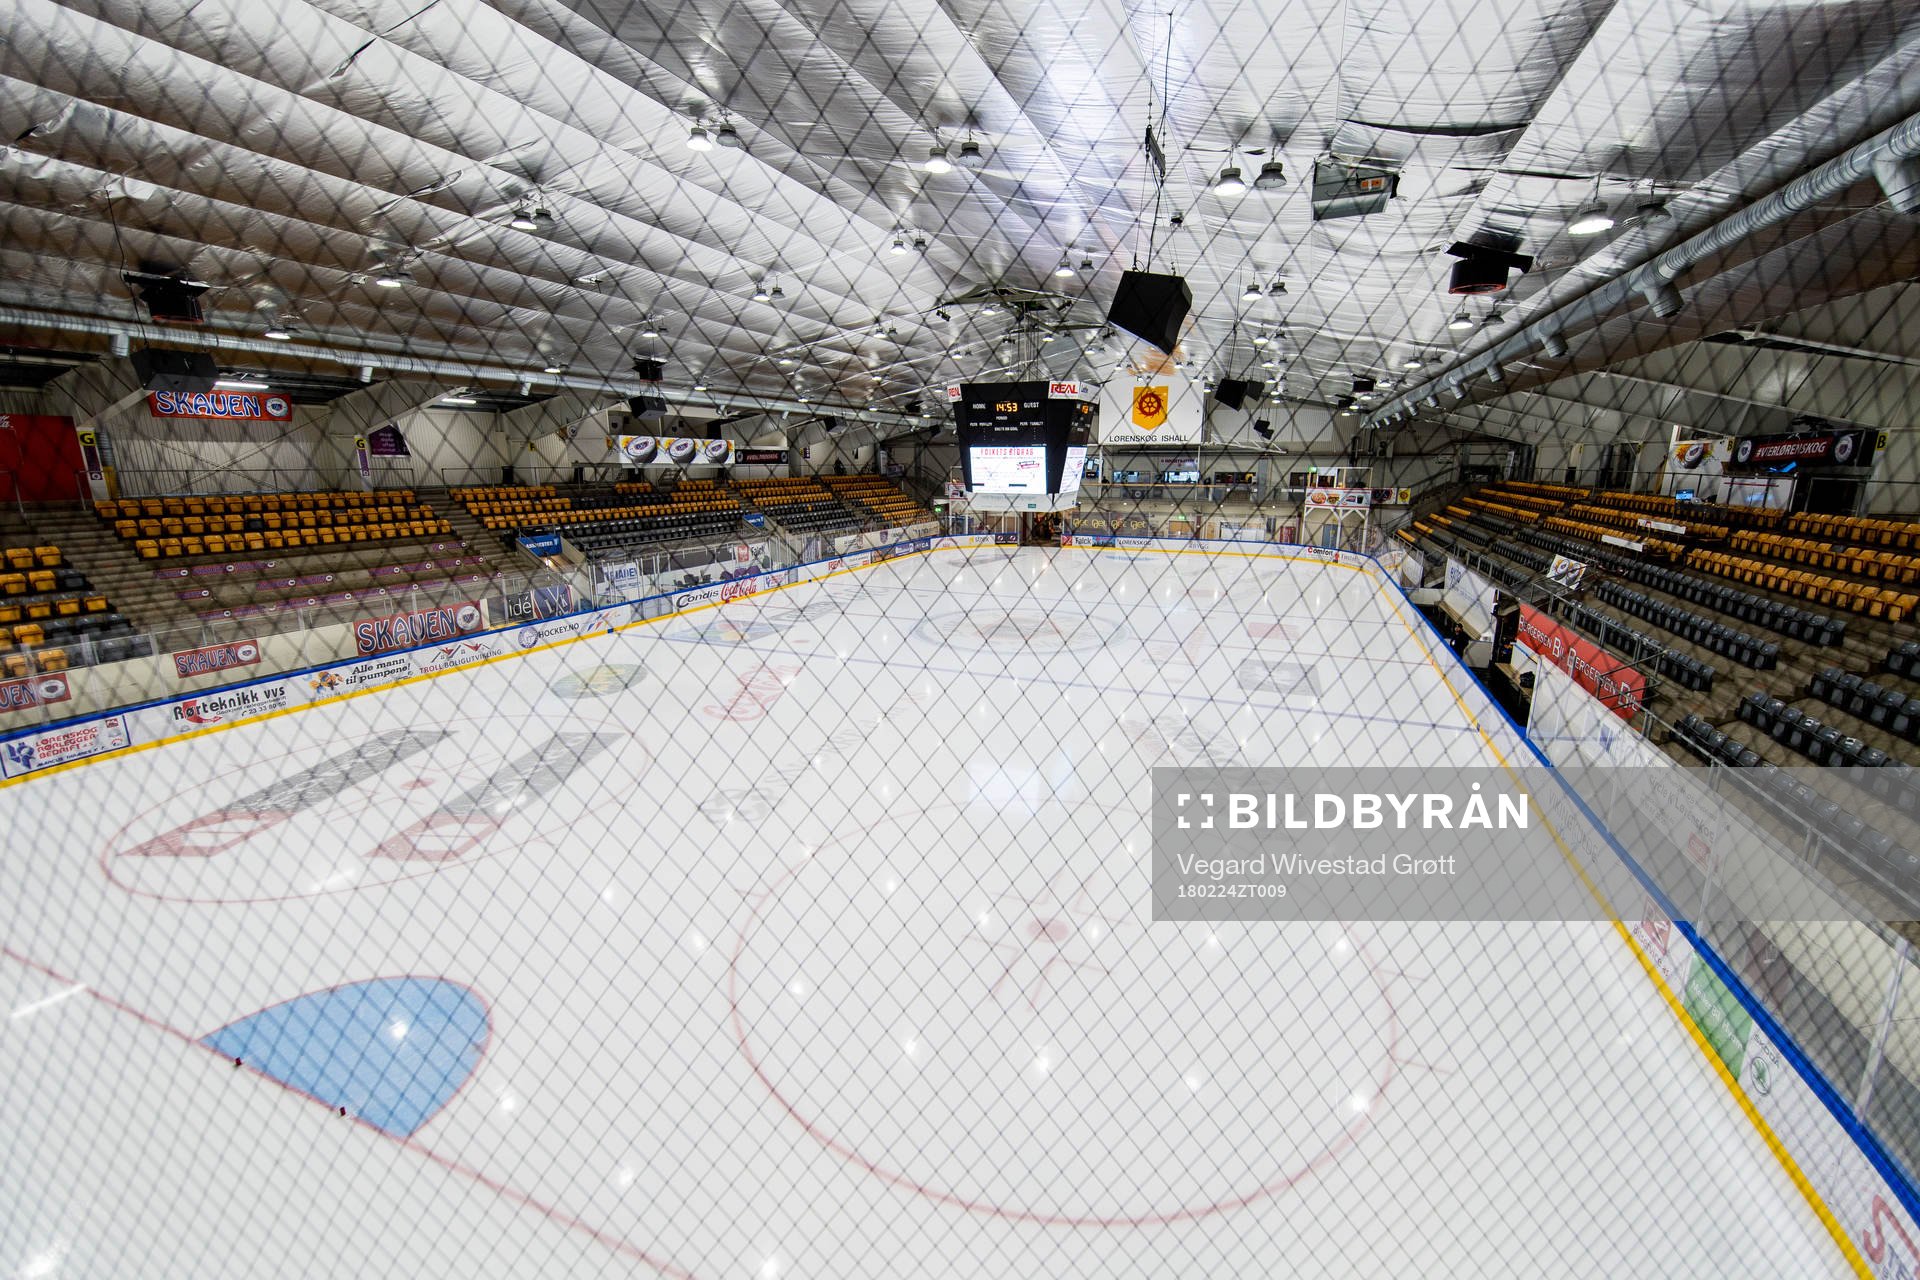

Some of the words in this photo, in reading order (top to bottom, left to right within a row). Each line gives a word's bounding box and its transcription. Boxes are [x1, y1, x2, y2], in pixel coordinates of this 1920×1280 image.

[1051, 384, 1078, 394] REAL
[996, 403, 1018, 412] 14:53
[80, 433, 94, 445] G
[357, 440, 365, 448] G
[1161, 434, 1188, 442] ISHALL
[1877, 434, 1887, 449] B
[1308, 547, 1333, 556] Comfort
[508, 595, 532, 617] idé
[676, 589, 719, 608] Condis
[358, 608, 457, 653] SKAUEN
[538, 623, 580, 638] HOCKEY.NO
[176, 647, 238, 674] SKAUEN
[352, 663, 374, 675] Alle
[377, 657, 405, 668] mann
[419, 664, 443, 674] TROLL
[444, 648, 502, 668] BOLIGUTVIKLING
[345, 674, 357, 685] til
[359, 663, 411, 684] pumpene!
[173, 689, 259, 720] Rørteknikk
[39, 743, 81, 760] BEDRIFT
